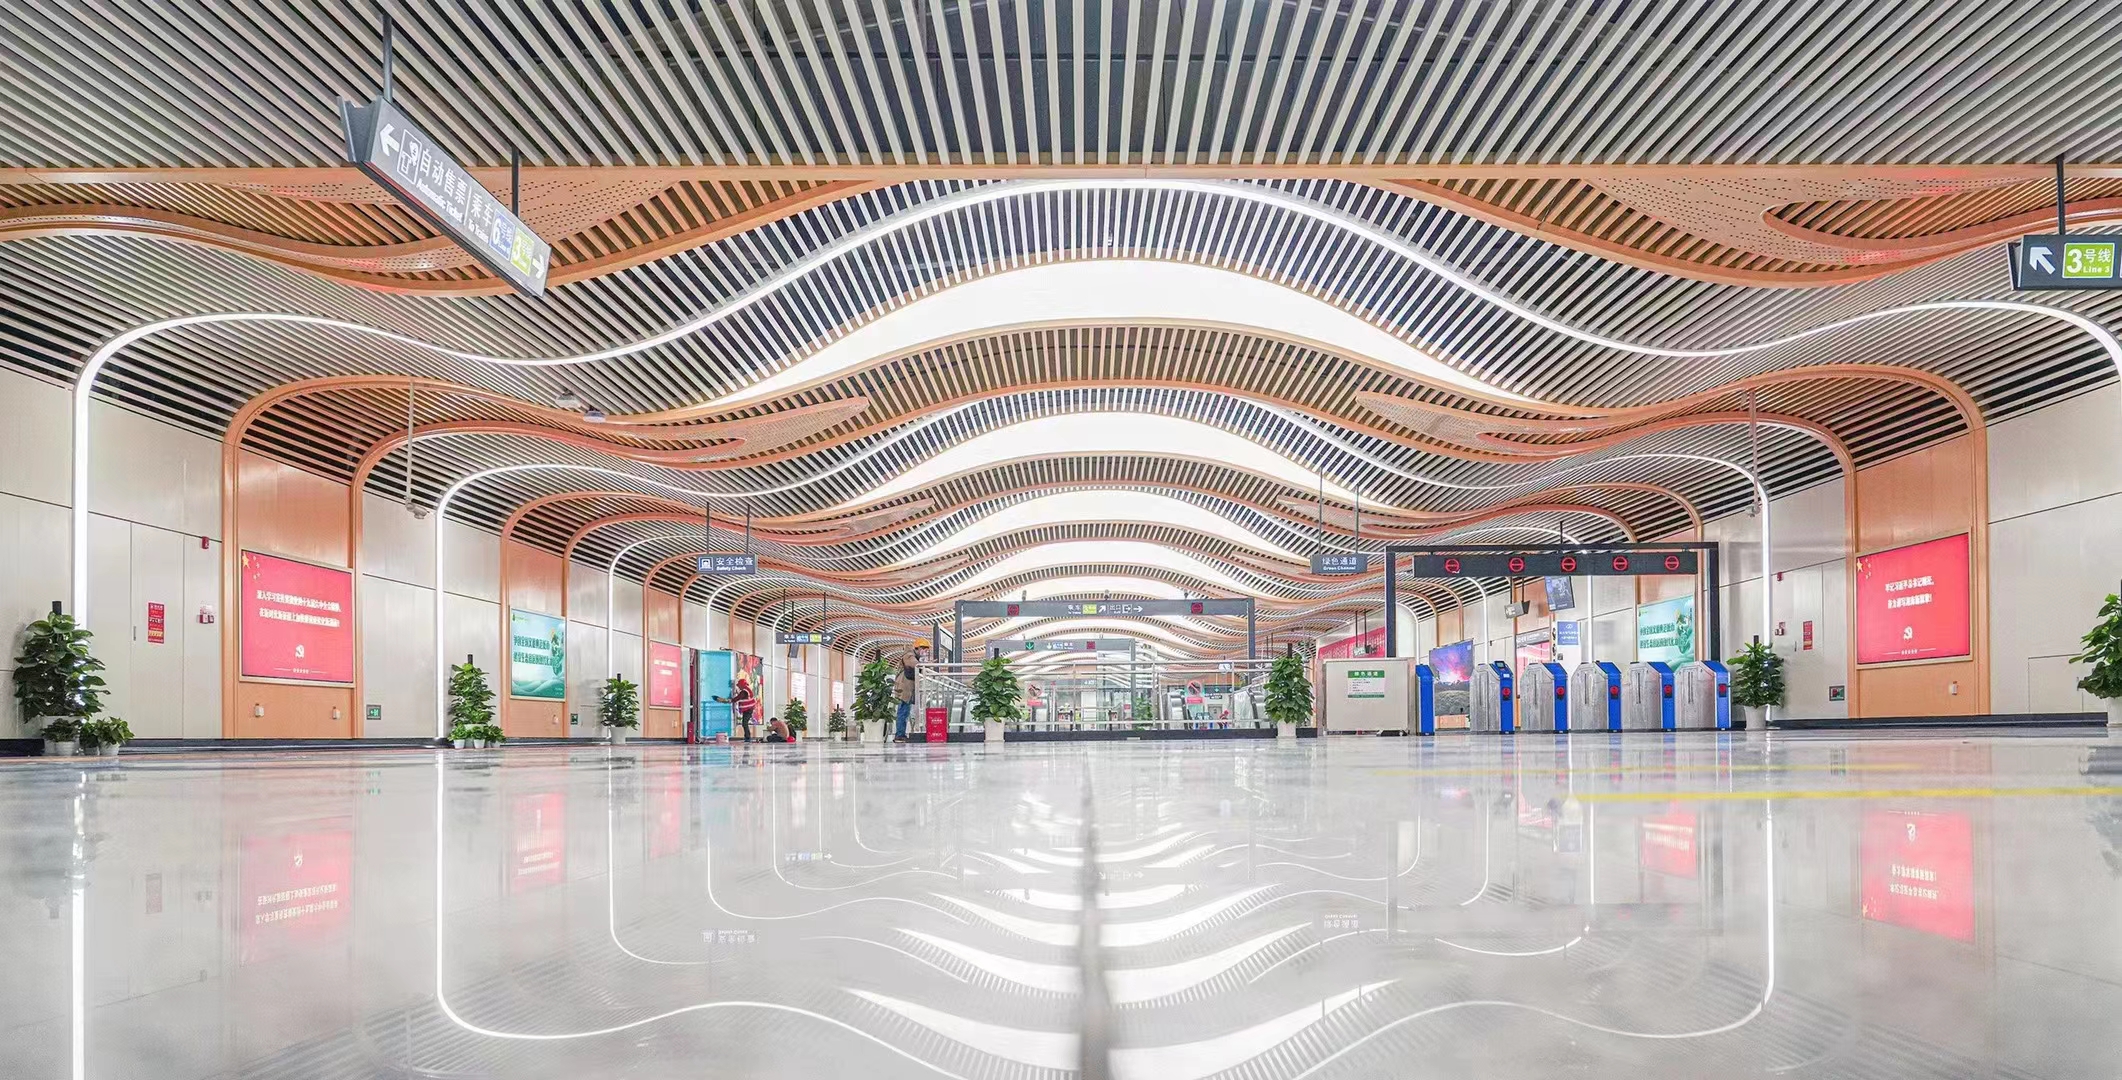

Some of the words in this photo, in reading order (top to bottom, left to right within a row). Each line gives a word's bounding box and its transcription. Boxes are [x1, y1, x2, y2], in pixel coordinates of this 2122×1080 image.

[420, 149, 468, 206] 自动售票
[471, 193, 494, 226] 乘车
[716, 556, 753, 566] 安全检查
[1322, 556, 1357, 565] 绿色通道
